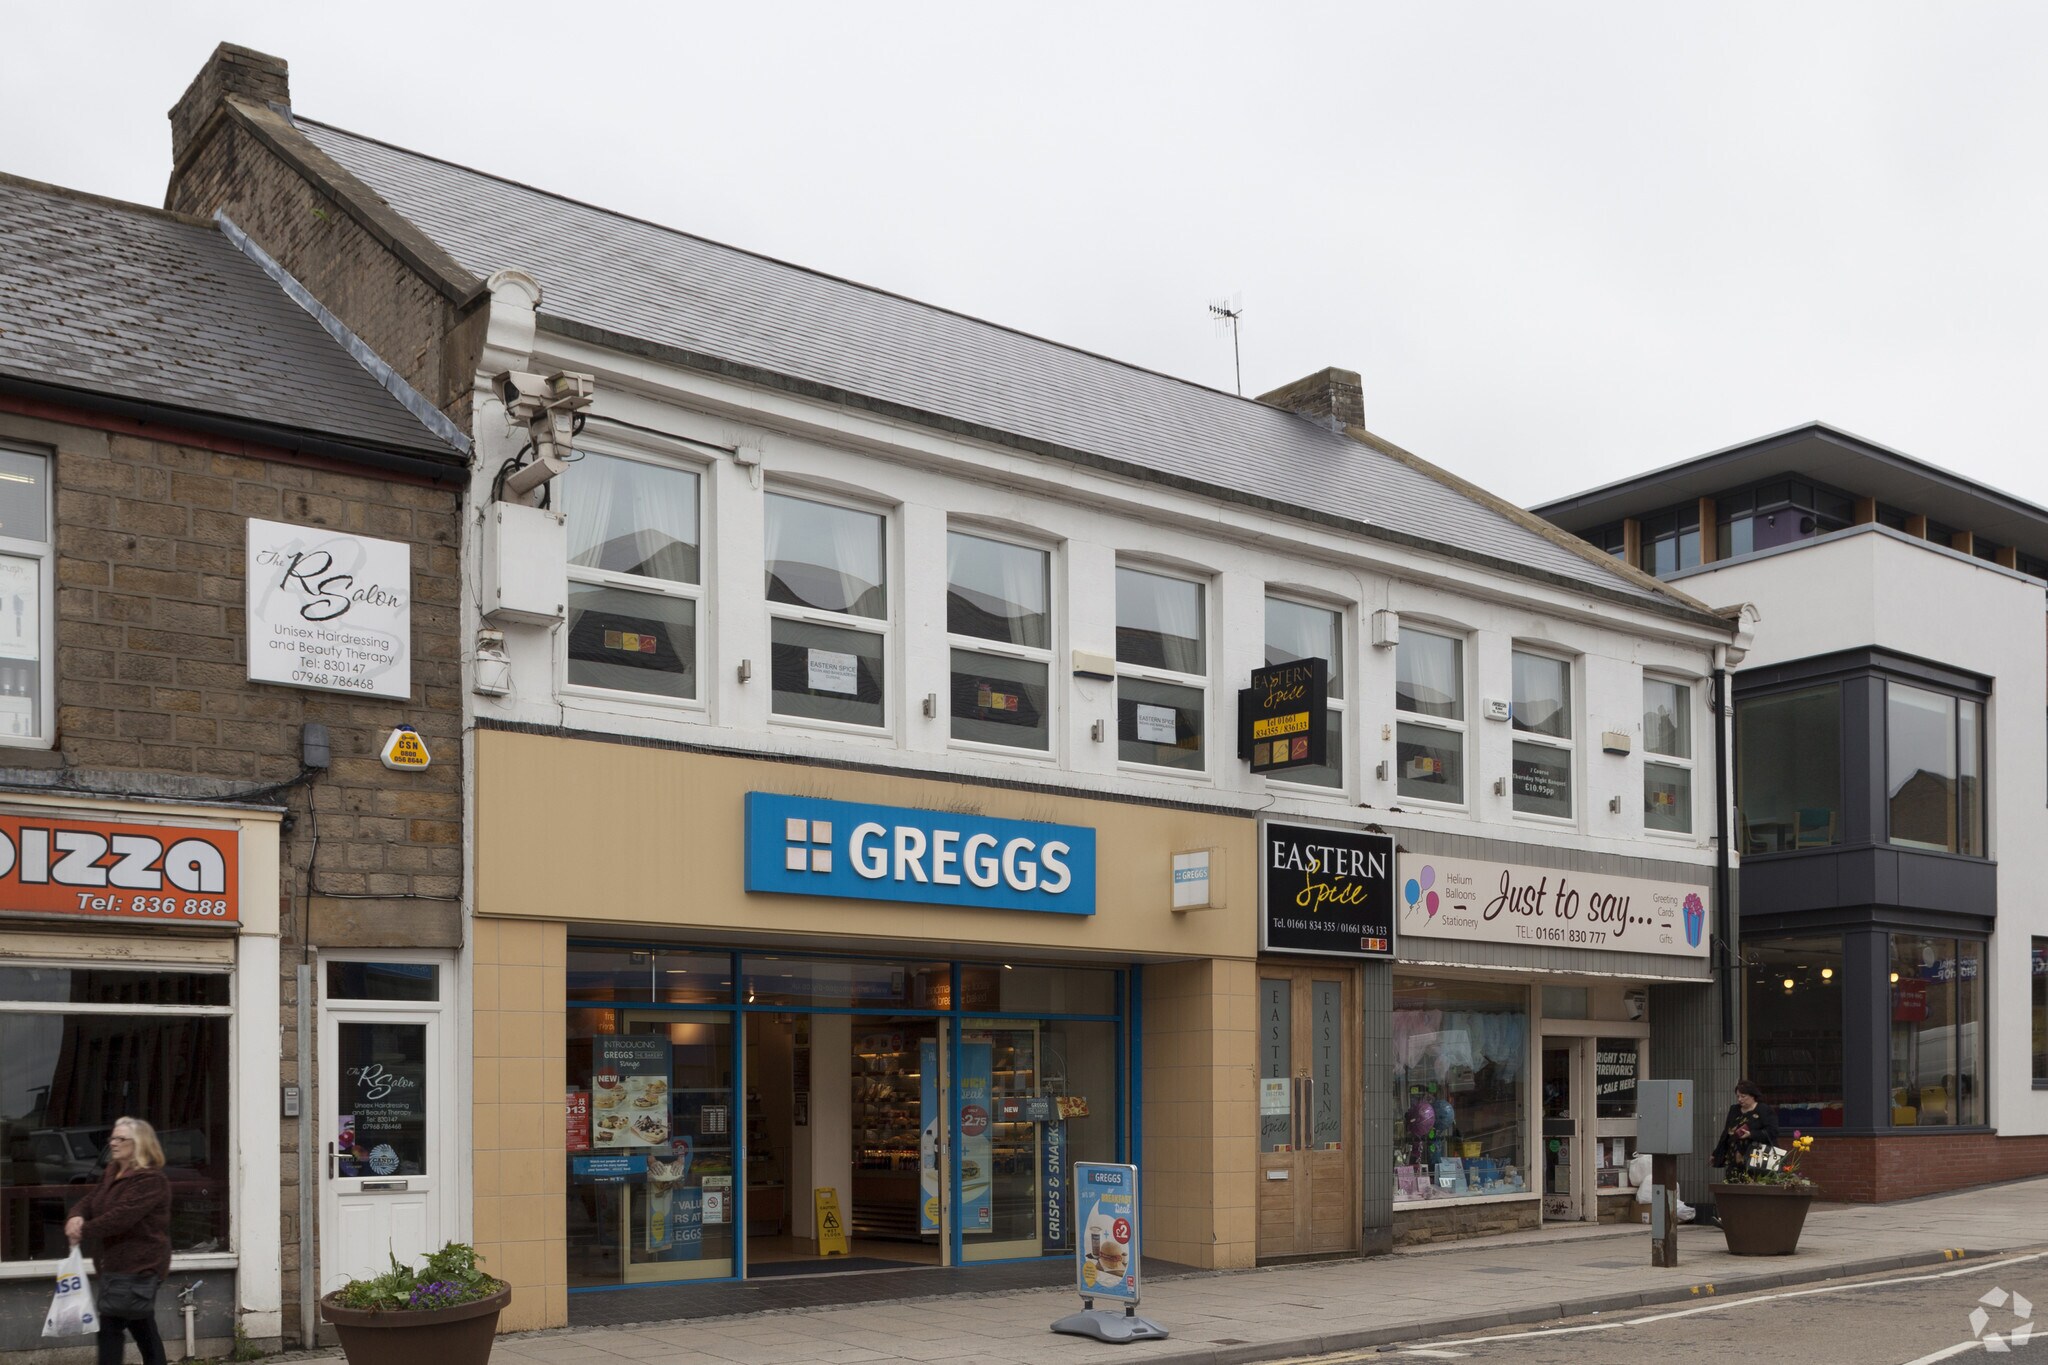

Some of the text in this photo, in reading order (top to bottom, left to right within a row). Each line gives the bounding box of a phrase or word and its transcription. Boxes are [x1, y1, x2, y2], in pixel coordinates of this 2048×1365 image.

[256, 550, 285, 567] The
[274, 623, 390, 651] Unisex Hairdressing
[269, 640, 395, 666] and Beauty Therapy
[300, 656, 366, 675] Tel: 830147
[810, 660, 856, 674] EASTERN SPICE
[292, 670, 375, 690] 07968 786468
[1253, 664, 1313, 691] EASTERN
[1263, 676, 1306, 709] Spice
[1139, 715, 1161, 723] EASTERN
[1267, 714, 1296, 727] Tel 01661
[1255, 726, 1279, 737] 834355
[1283, 721, 1307, 732] 836133
[1525, 783, 1555, 796] £10.95pp
[0, 826, 226, 894] izza
[850, 821, 1072, 894] GREGGS
[1272, 840, 1387, 880] EASTERN
[1182, 870, 1208, 880] GREGGS
[1446, 873, 1473, 886] Helium
[1296, 859, 1368, 913] Spice
[1445, 887, 1477, 901] Balloons
[1652, 892, 1679, 907] Greeting
[76, 892, 227, 916] Tel: 836 888
[1483, 869, 1653, 938] Just to say...
[1657, 907, 1675, 918] Cards
[1273, 918, 1286, 928] Tel.
[1287, 919, 1307, 930] 01661
[1309, 920, 1322, 931] 834
[1323, 921, 1336, 932] 355
[1341, 922, 1360, 934] 01661
[1361, 925, 1375, 935] 836
[1376, 926, 1387, 936] 133
[1442, 914, 1479, 930] Stationery
[1516, 925, 1606, 944] TEL: 01661 830 777
[1659, 933, 1673, 945] Gifts
[604, 1041, 656, 1049] INTRODUCING
[1322, 991, 1332, 1113] EASTERN
[604, 1051, 634, 1059] GREGGS
[1619, 1053, 1637, 1064] STAR
[619, 1060, 641, 1069] Range
[1596, 1064, 1634, 1076] FIREWORKS
[598, 1074, 617, 1083] NEW
[1603, 1081, 1618, 1094] SALE
[1619, 1078, 1636, 1091] HERE
[388, 1109, 412, 1117] Therapy
[1003, 1105, 1019, 1113] NEW
[1049, 1120, 1060, 1240] CRISPS & SNACKS
[1095, 1172, 1122, 1184] GREGGS
[1114, 1203, 1132, 1214] Deal
[1115, 1224, 1128, 1239] £2
